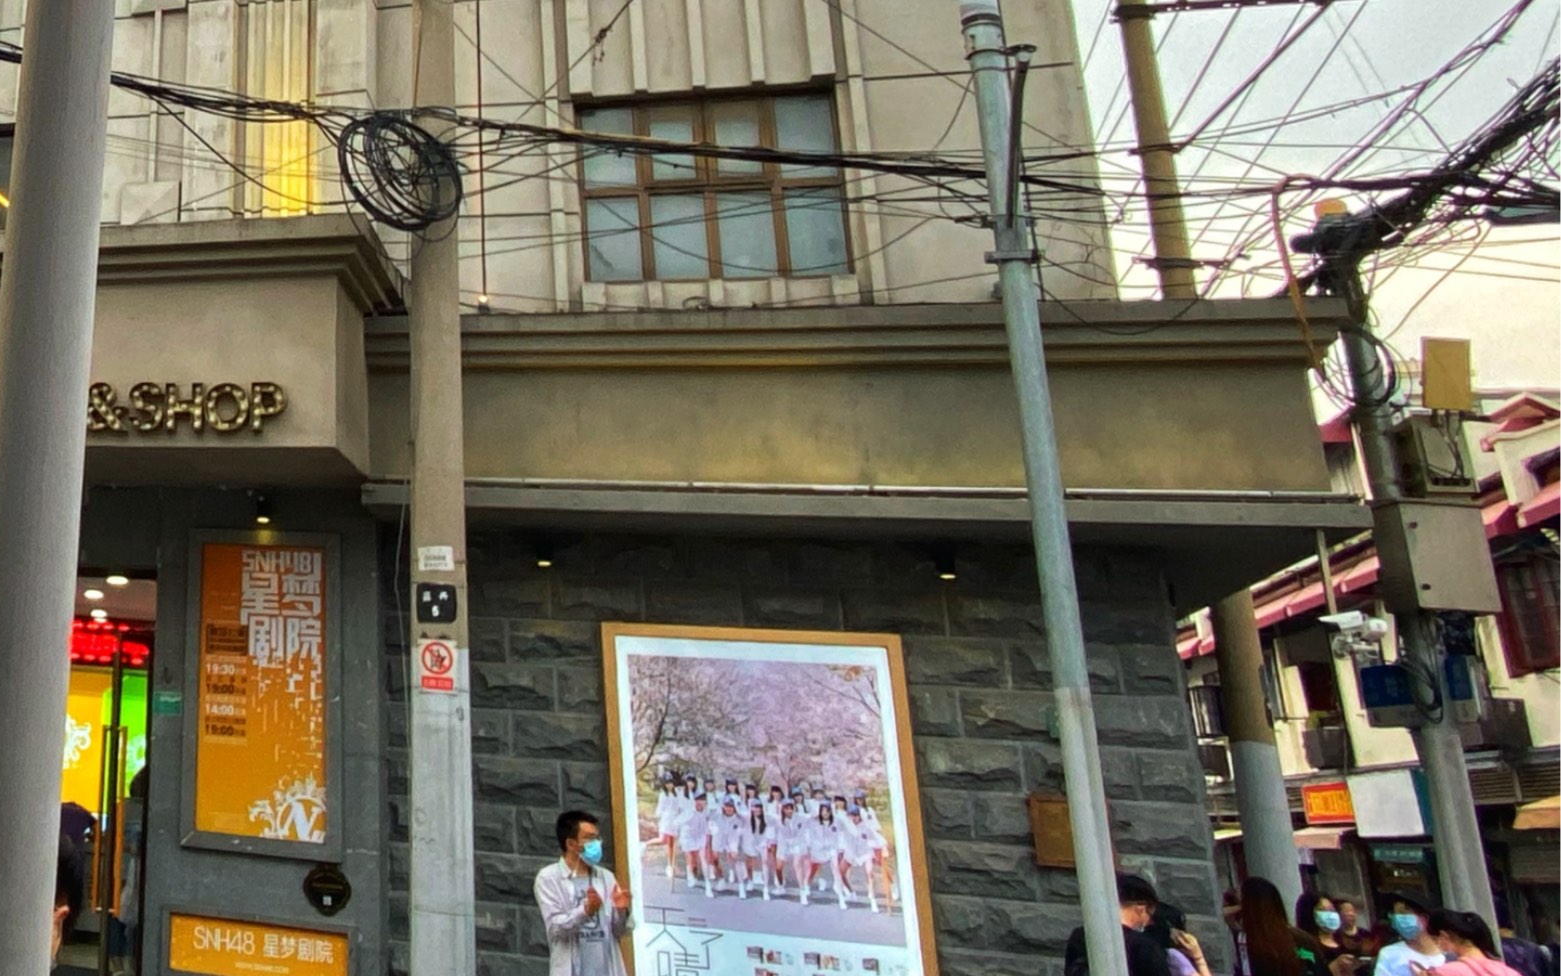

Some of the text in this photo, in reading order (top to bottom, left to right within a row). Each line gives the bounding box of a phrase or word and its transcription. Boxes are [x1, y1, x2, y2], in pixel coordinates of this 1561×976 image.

[205, 663, 235, 676] 19:30
[193, 925, 335, 965] SNH48 星梦剧院
